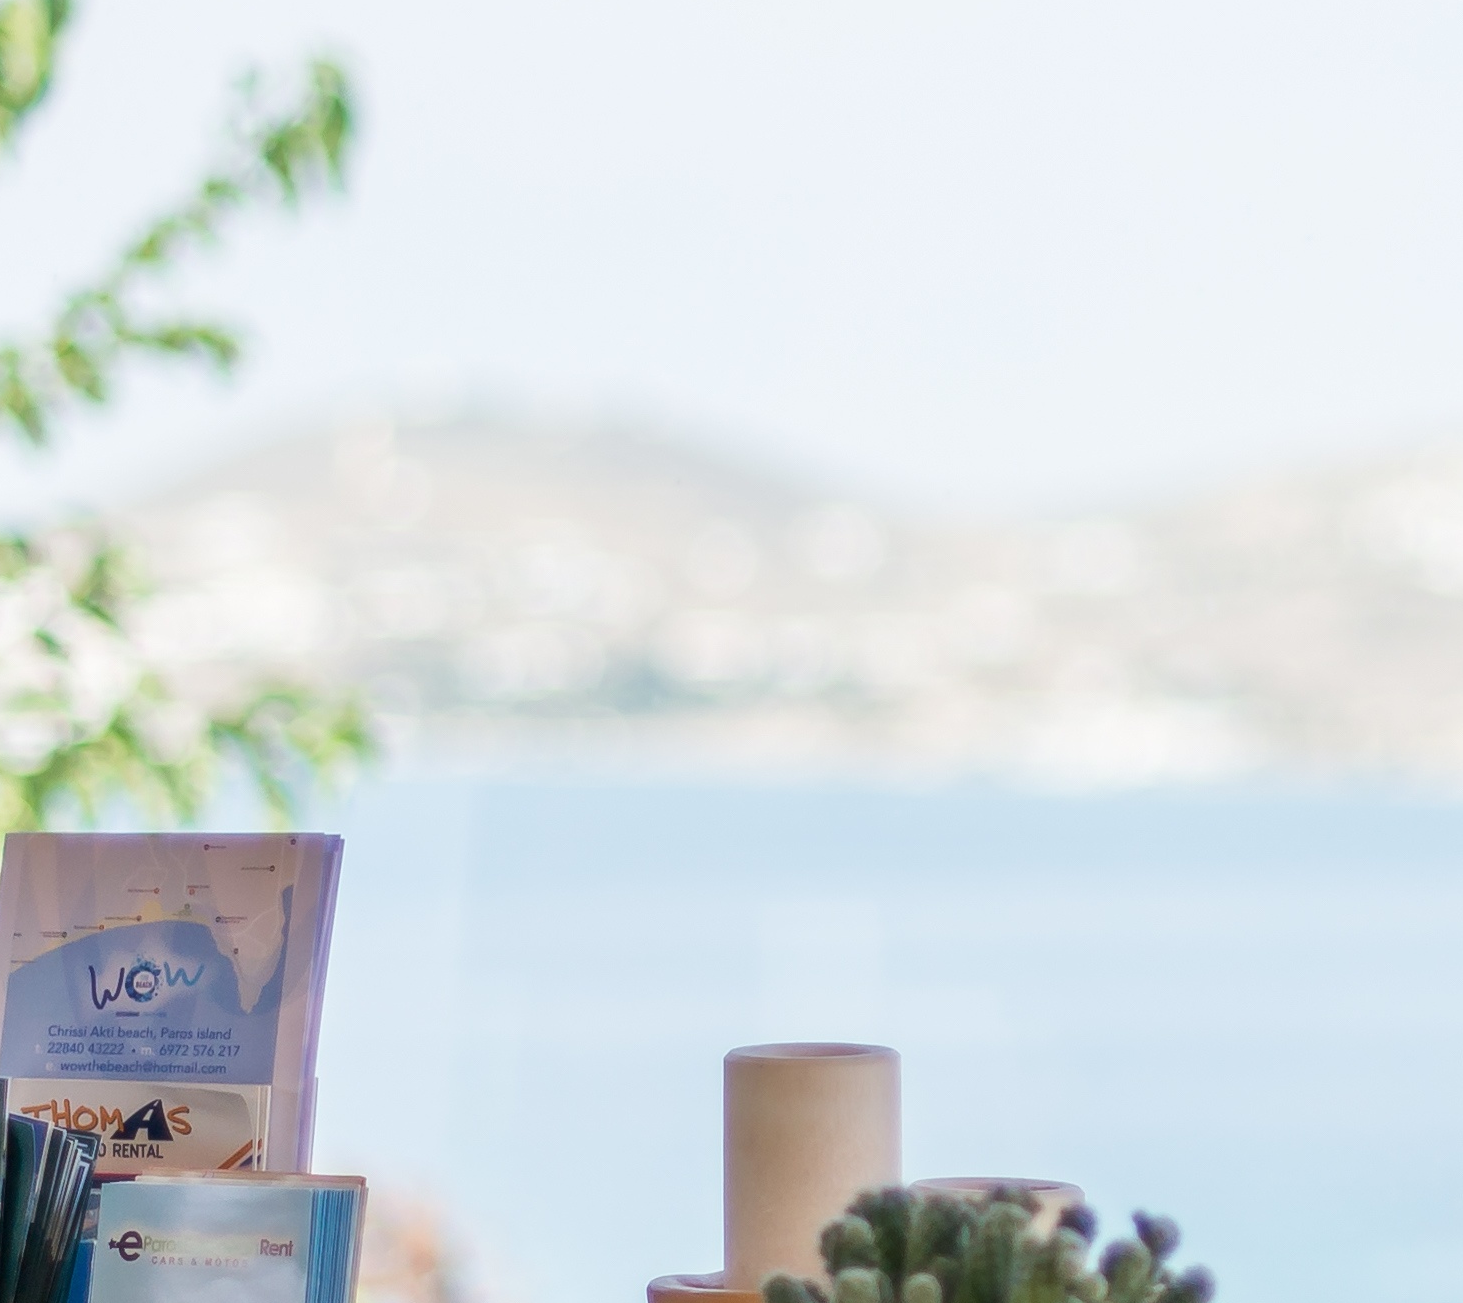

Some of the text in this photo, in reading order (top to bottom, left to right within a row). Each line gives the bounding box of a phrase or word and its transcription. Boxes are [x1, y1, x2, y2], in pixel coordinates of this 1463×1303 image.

[47, 1024, 232, 1041] Chrissi Akti beach, Paros island
[47, 1042, 84, 1055] 22840
[88, 1043, 125, 1056] 43222
[159, 1044, 190, 1057] 6972
[192, 1044, 215, 1058] 576
[218, 1045, 241, 1058] 217
[60, 1060, 227, 1074] wowthebeach@hotmail.com
[21, 1099, 192, 1141] THOMAS
[113, 1143, 164, 1159] RENTAL
[259, 1238, 294, 1258] Rent
[151, 1256, 184, 1266] CARS
